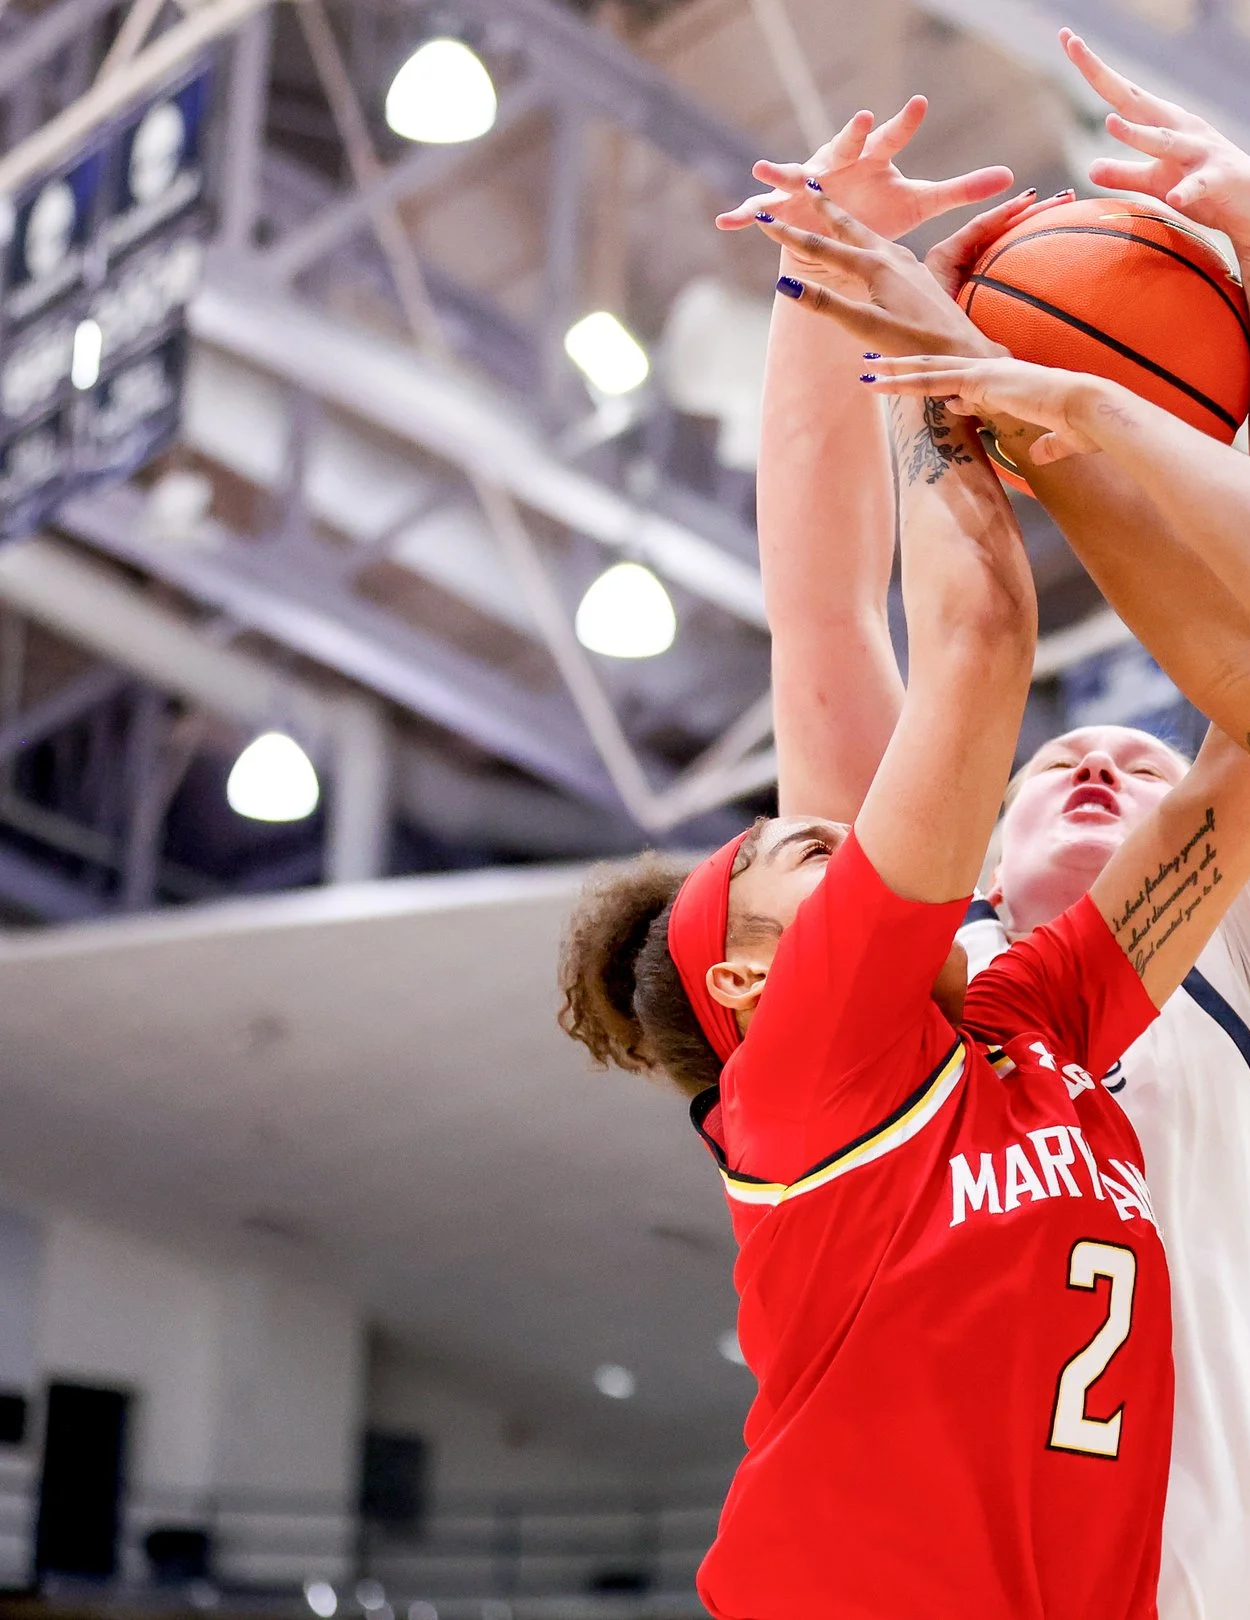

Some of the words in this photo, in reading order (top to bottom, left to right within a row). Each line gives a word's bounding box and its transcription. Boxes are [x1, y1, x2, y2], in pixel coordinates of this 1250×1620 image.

[1122, 890, 1146, 926] about
[1144, 856, 1181, 903] finding
[1180, 807, 1216, 863] yourself
[1128, 918, 1152, 953] about
[1151, 870, 1199, 924] discovering
[1199, 843, 1217, 870] who
[1134, 942, 1155, 979] God
[1155, 909, 1184, 949] created
[1184, 896, 1203, 921] you
[1203, 884, 1213, 896] to
[949, 1125, 1163, 1240] MARYAN
[1046, 1236, 1136, 1461] 2
